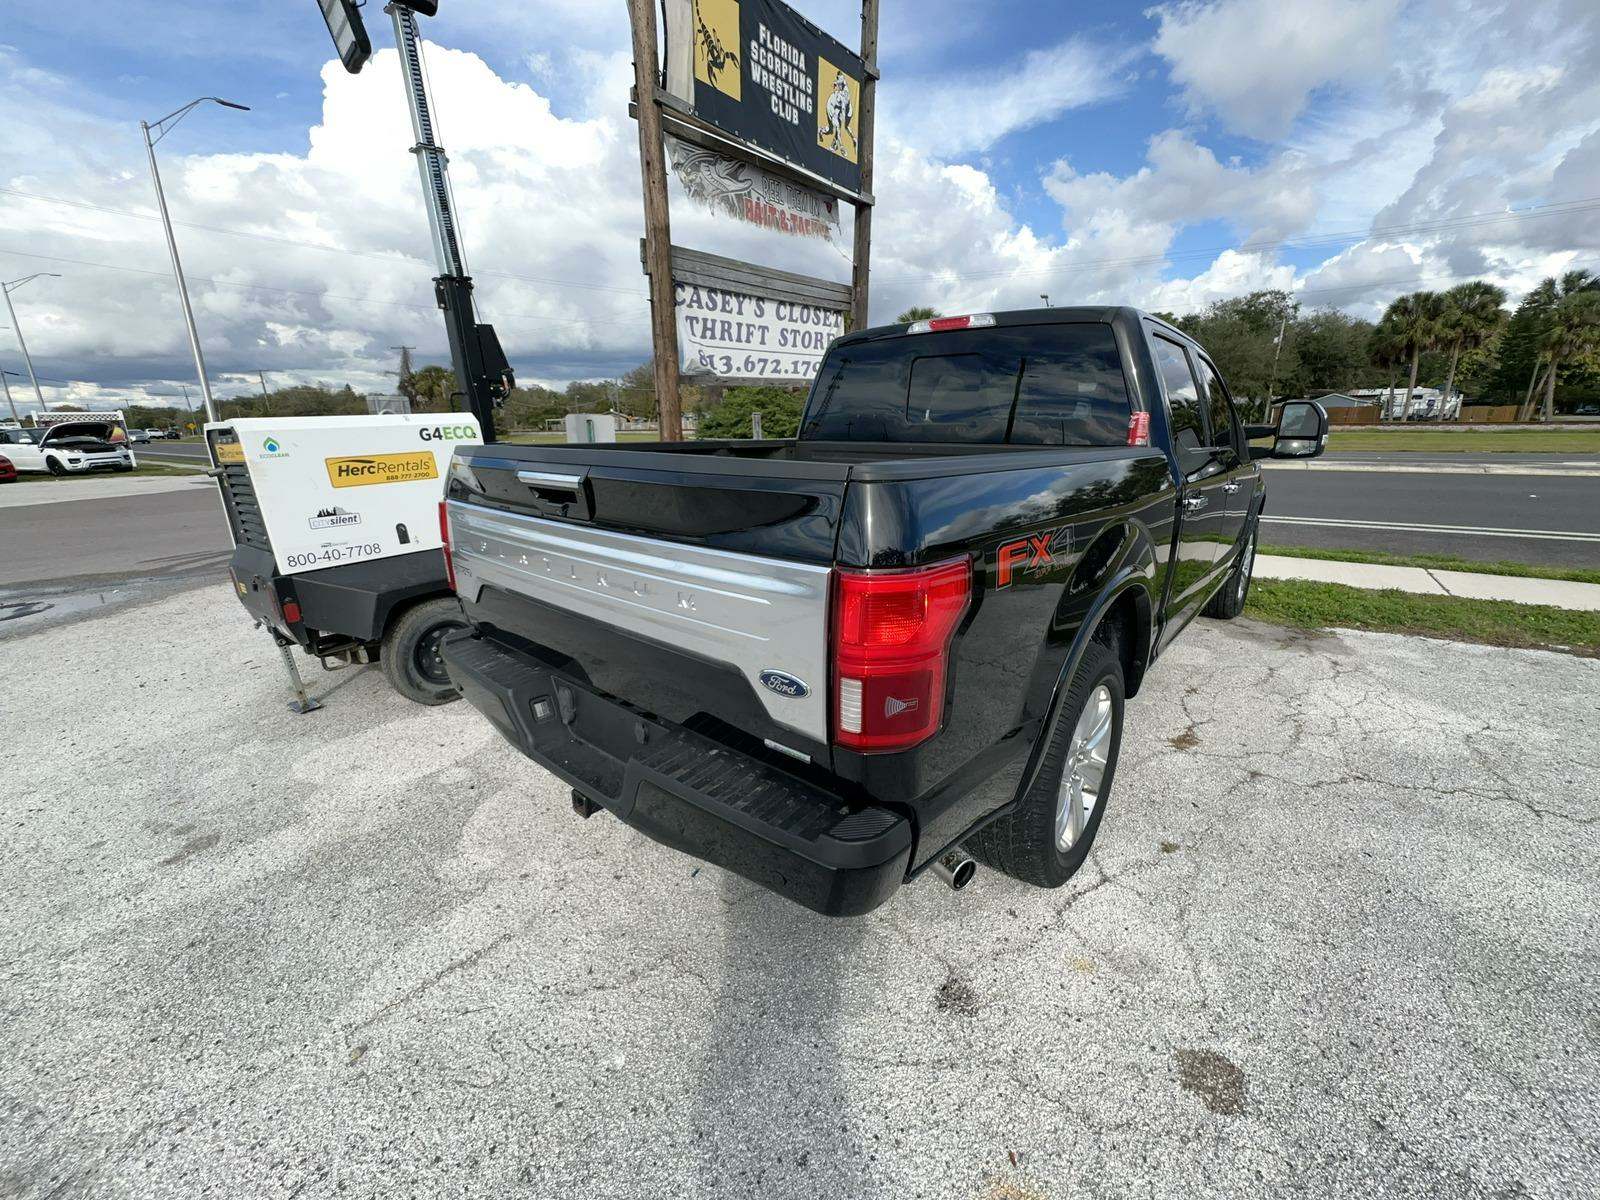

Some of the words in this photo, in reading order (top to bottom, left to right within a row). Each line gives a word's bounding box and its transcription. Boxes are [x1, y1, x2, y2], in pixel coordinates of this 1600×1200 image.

[750, 40, 813, 95] SCORPIONS
[759, 22, 806, 72] FLORIDA
[750, 59, 813, 115] WRESTLING
[771, 94, 799, 126] CLUB
[673, 283, 765, 318] CASEY'S
[775, 300, 842, 329] CLOSET
[685, 315, 769, 346] THRIFT
[287, 543, 382, 568] 800-40-7708
[995, 523, 1076, 591] FX4
[768, 674, 797, 695] Ford
